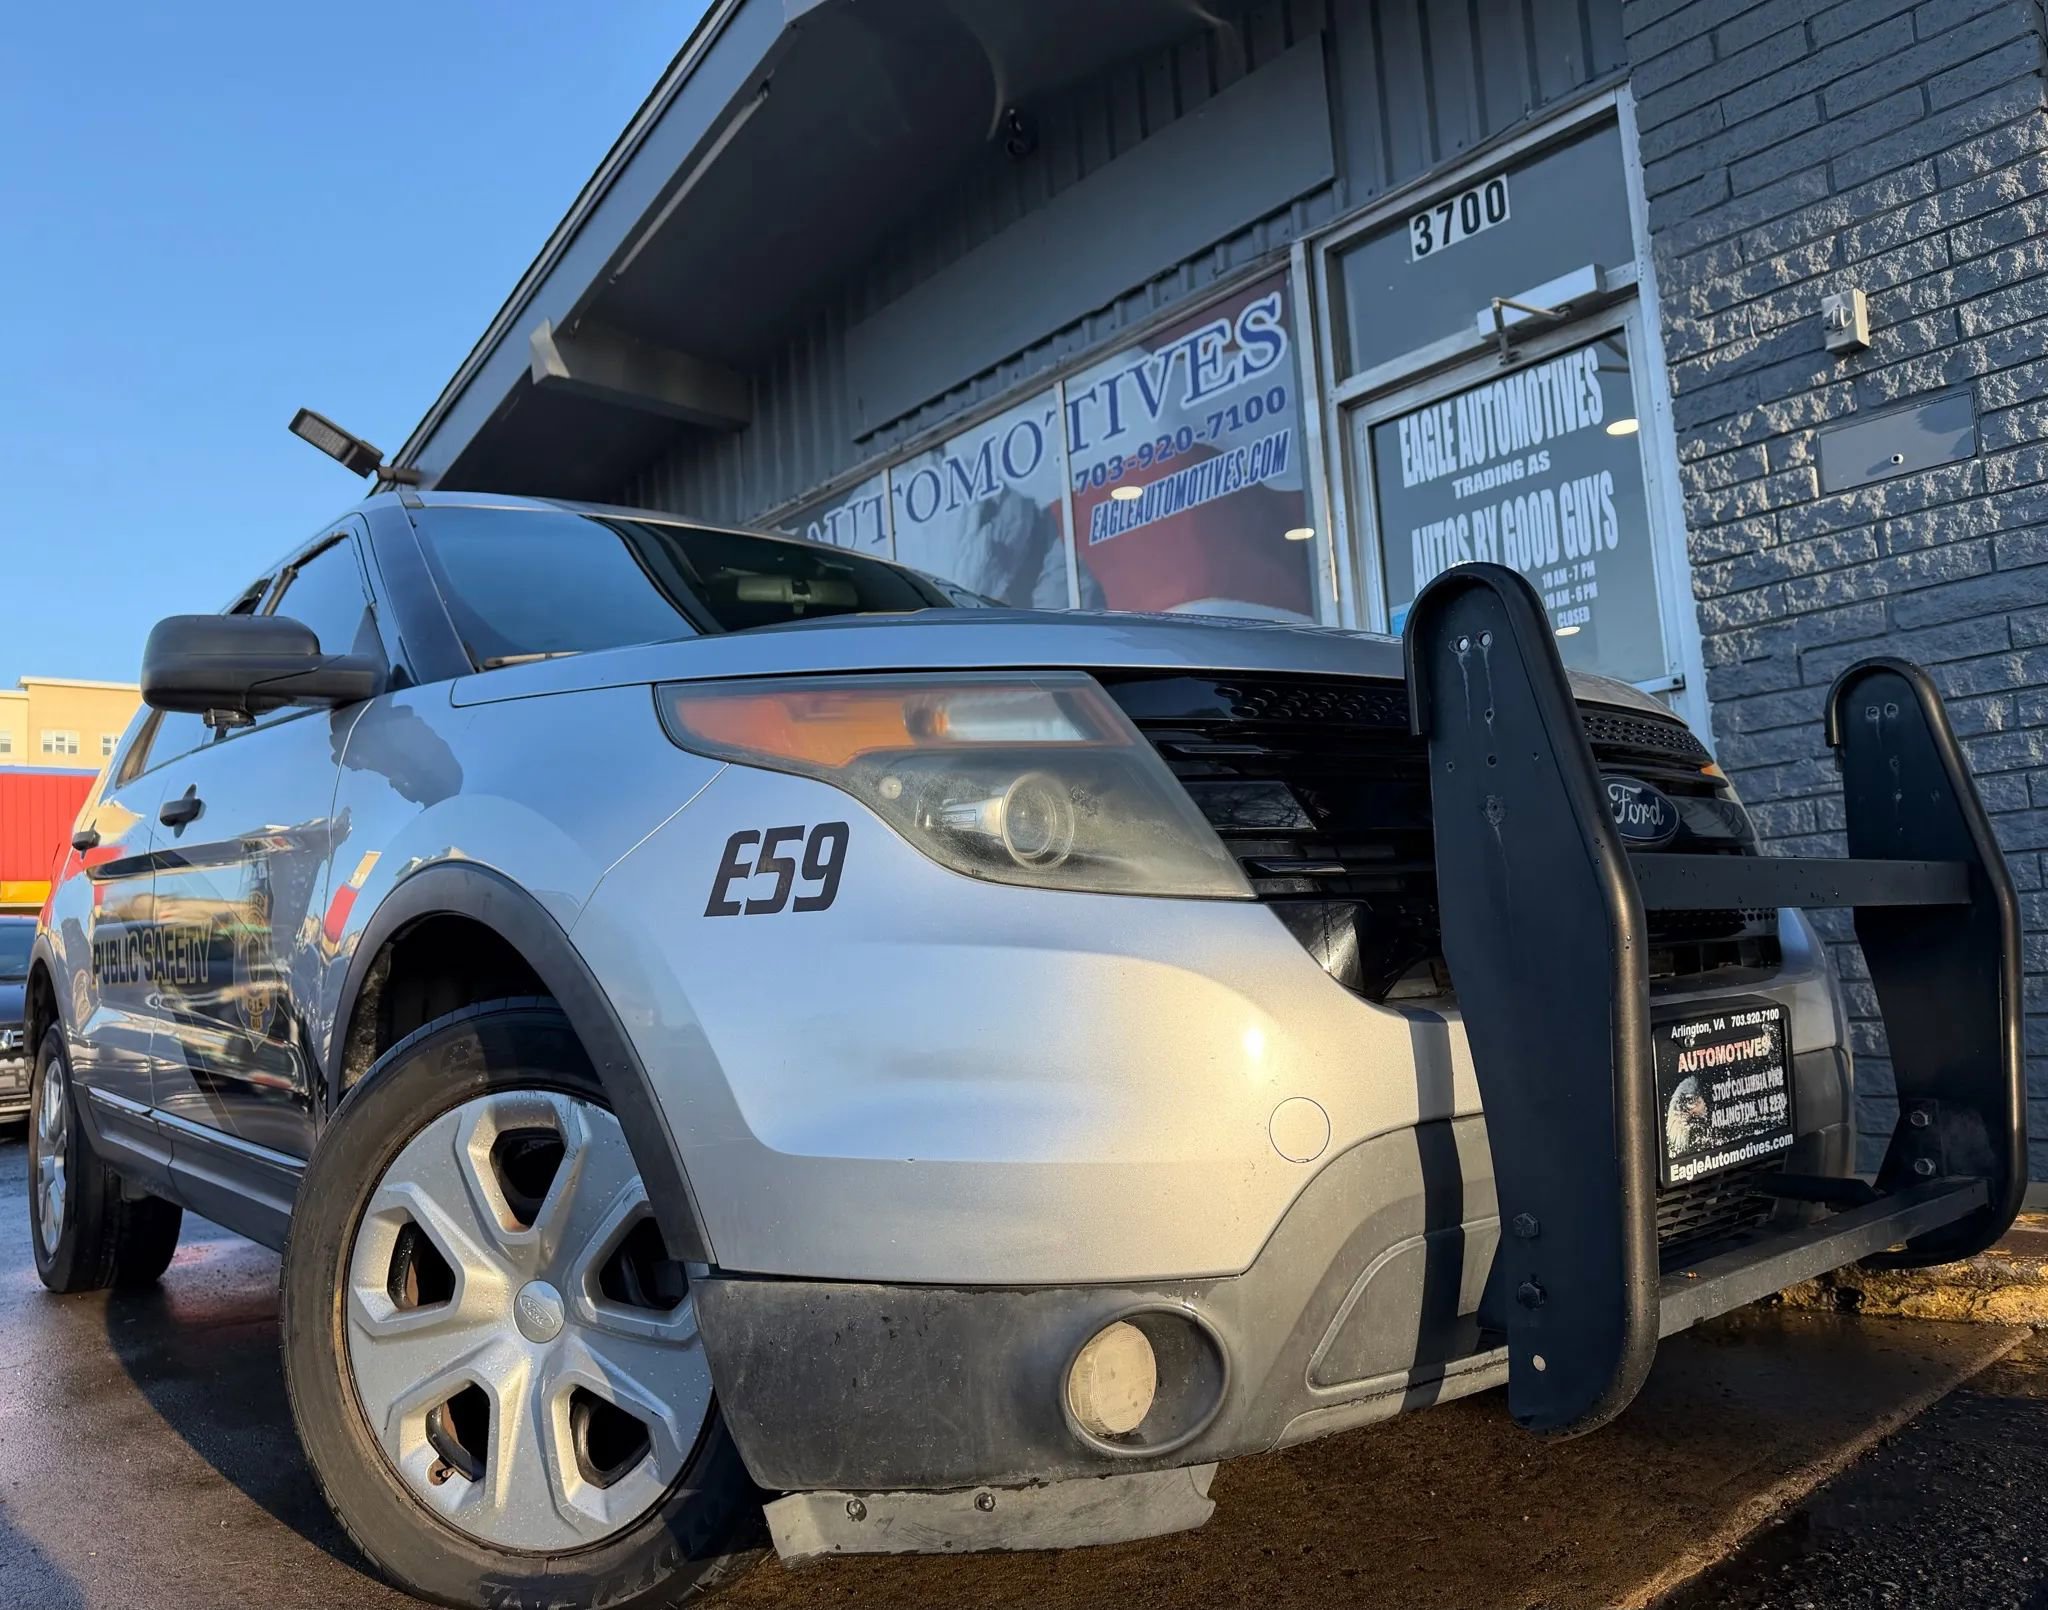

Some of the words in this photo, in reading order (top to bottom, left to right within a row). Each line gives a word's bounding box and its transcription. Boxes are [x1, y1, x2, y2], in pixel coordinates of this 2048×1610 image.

[1414, 180, 1506, 256] 3700
[1075, 386, 1286, 493] 703-920-7100
[1398, 401, 1457, 488] EAGLE
[1457, 346, 1603, 469] AUTOMOTIVES
[1089, 430, 1290, 545] EAGLEAUTOMOTIVES.COM
[1452, 459, 1525, 499] TRADING
[1528, 450, 1550, 476] AS
[1411, 513, 1472, 598] AUTOS
[1472, 504, 1498, 563] BY
[1501, 489, 1560, 572] GOOD
[1559, 470, 1619, 560] GUYS
[1542, 572, 1553, 589] 10
[1554, 568, 1568, 587] AM
[1572, 564, 1579, 581] 7
[1581, 560, 1596, 579] PM
[1556, 589, 1570, 608] AM
[1575, 586, 1583, 602] 6
[1583, 582, 1598, 601] PM
[1557, 606, 1590, 628] CLOSED
[1608, 783, 1664, 825] Ford
[703, 821, 849, 917] E59
[92, 931, 139, 988] PUBLIC
[143, 920, 212, 985] SAFETY
[1671, 1022, 1711, 1039] Arlington,
[1713, 1018, 1725, 1031] VA
[1731, 1008, 1779, 1027] 703.920.7100
[1678, 1034, 1771, 1073] AUTOMOTIVES
[1670, 1133, 1793, 1182] EagleAutomotives.com
